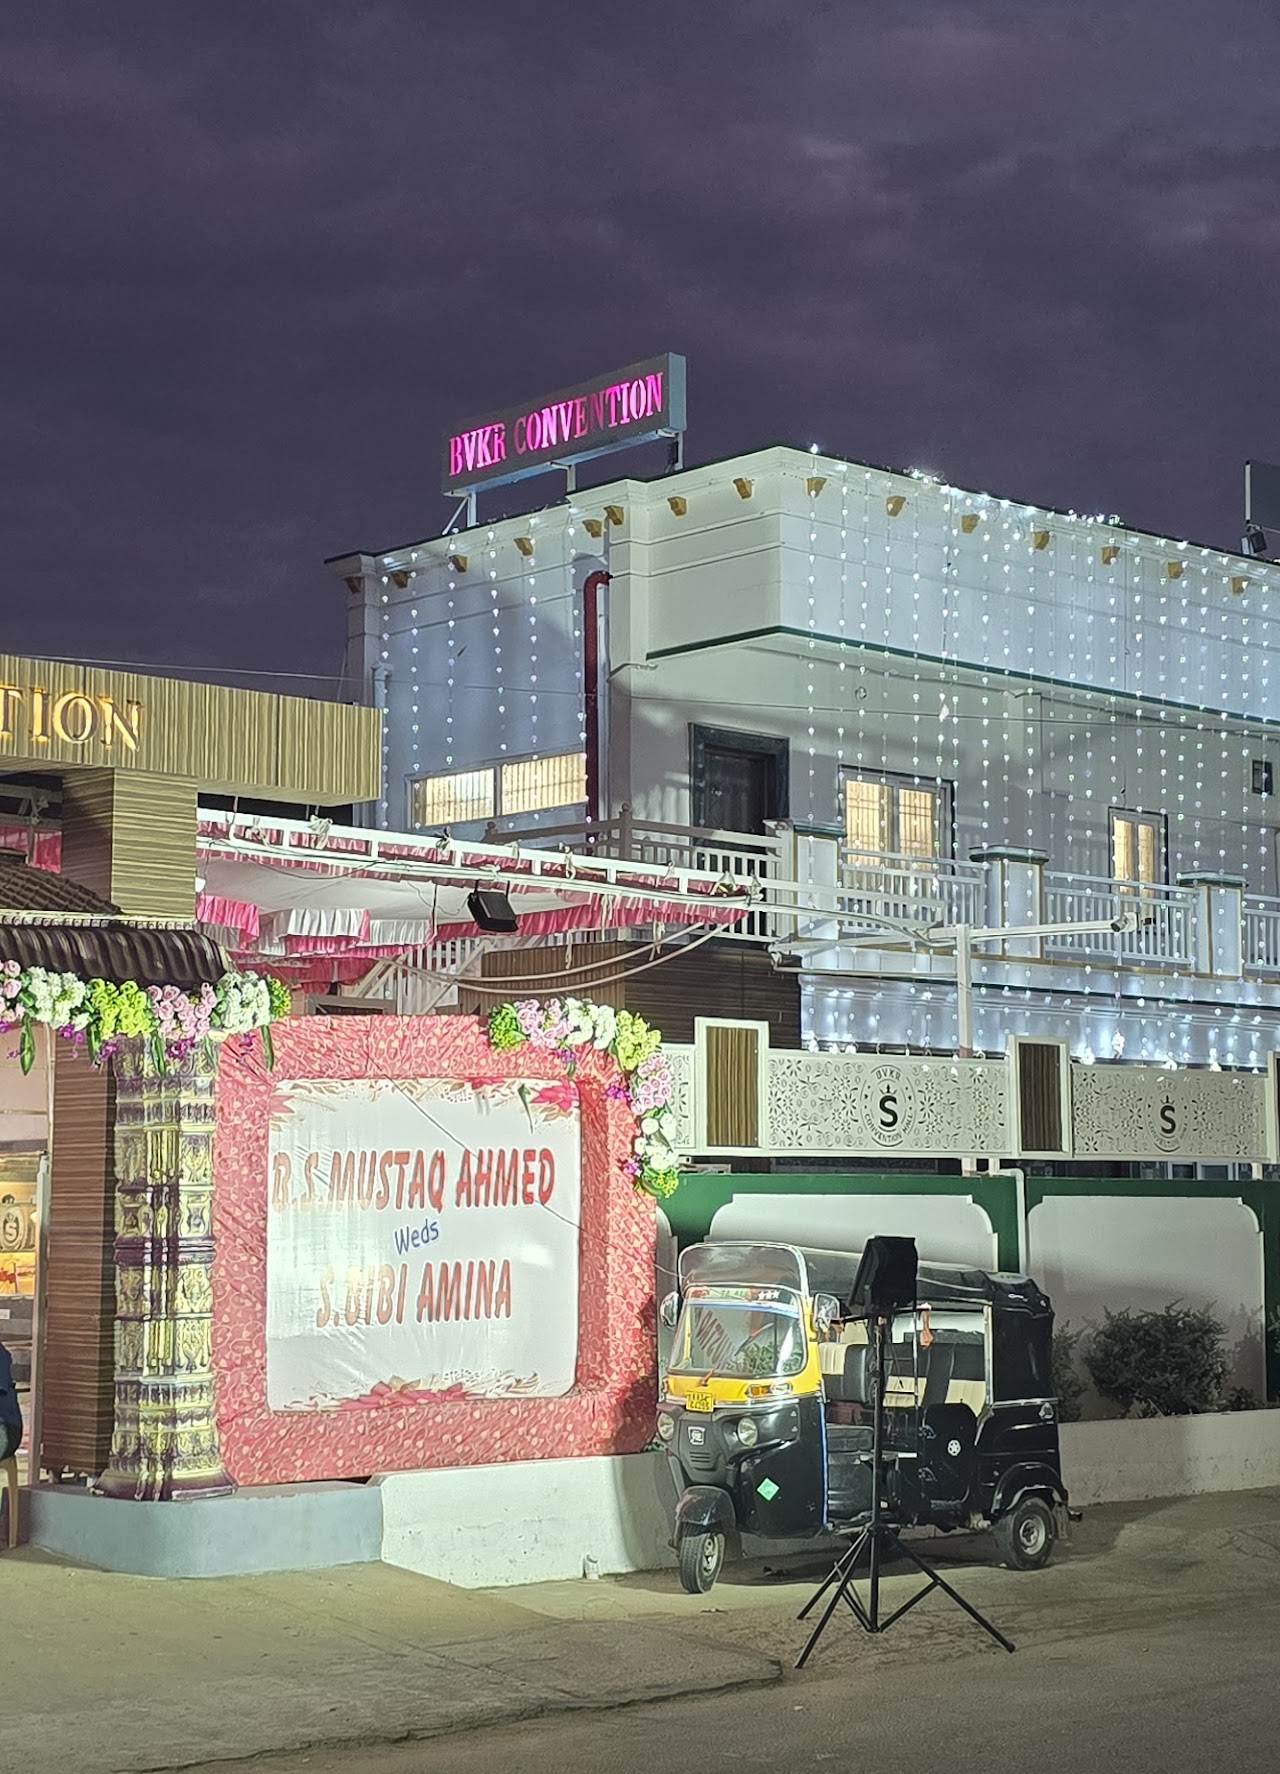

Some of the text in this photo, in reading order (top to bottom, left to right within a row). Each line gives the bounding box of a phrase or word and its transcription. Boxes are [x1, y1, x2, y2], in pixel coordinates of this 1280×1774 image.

[448, 371, 664, 477] BVKR CONVENTION
[879, 1095, 898, 1128] S
[1160, 1105, 1176, 1134] S
[455, 1147, 556, 1207] AHMED
[394, 1218, 440, 1256] Weds
[416, 1258, 513, 1324] AMINA
